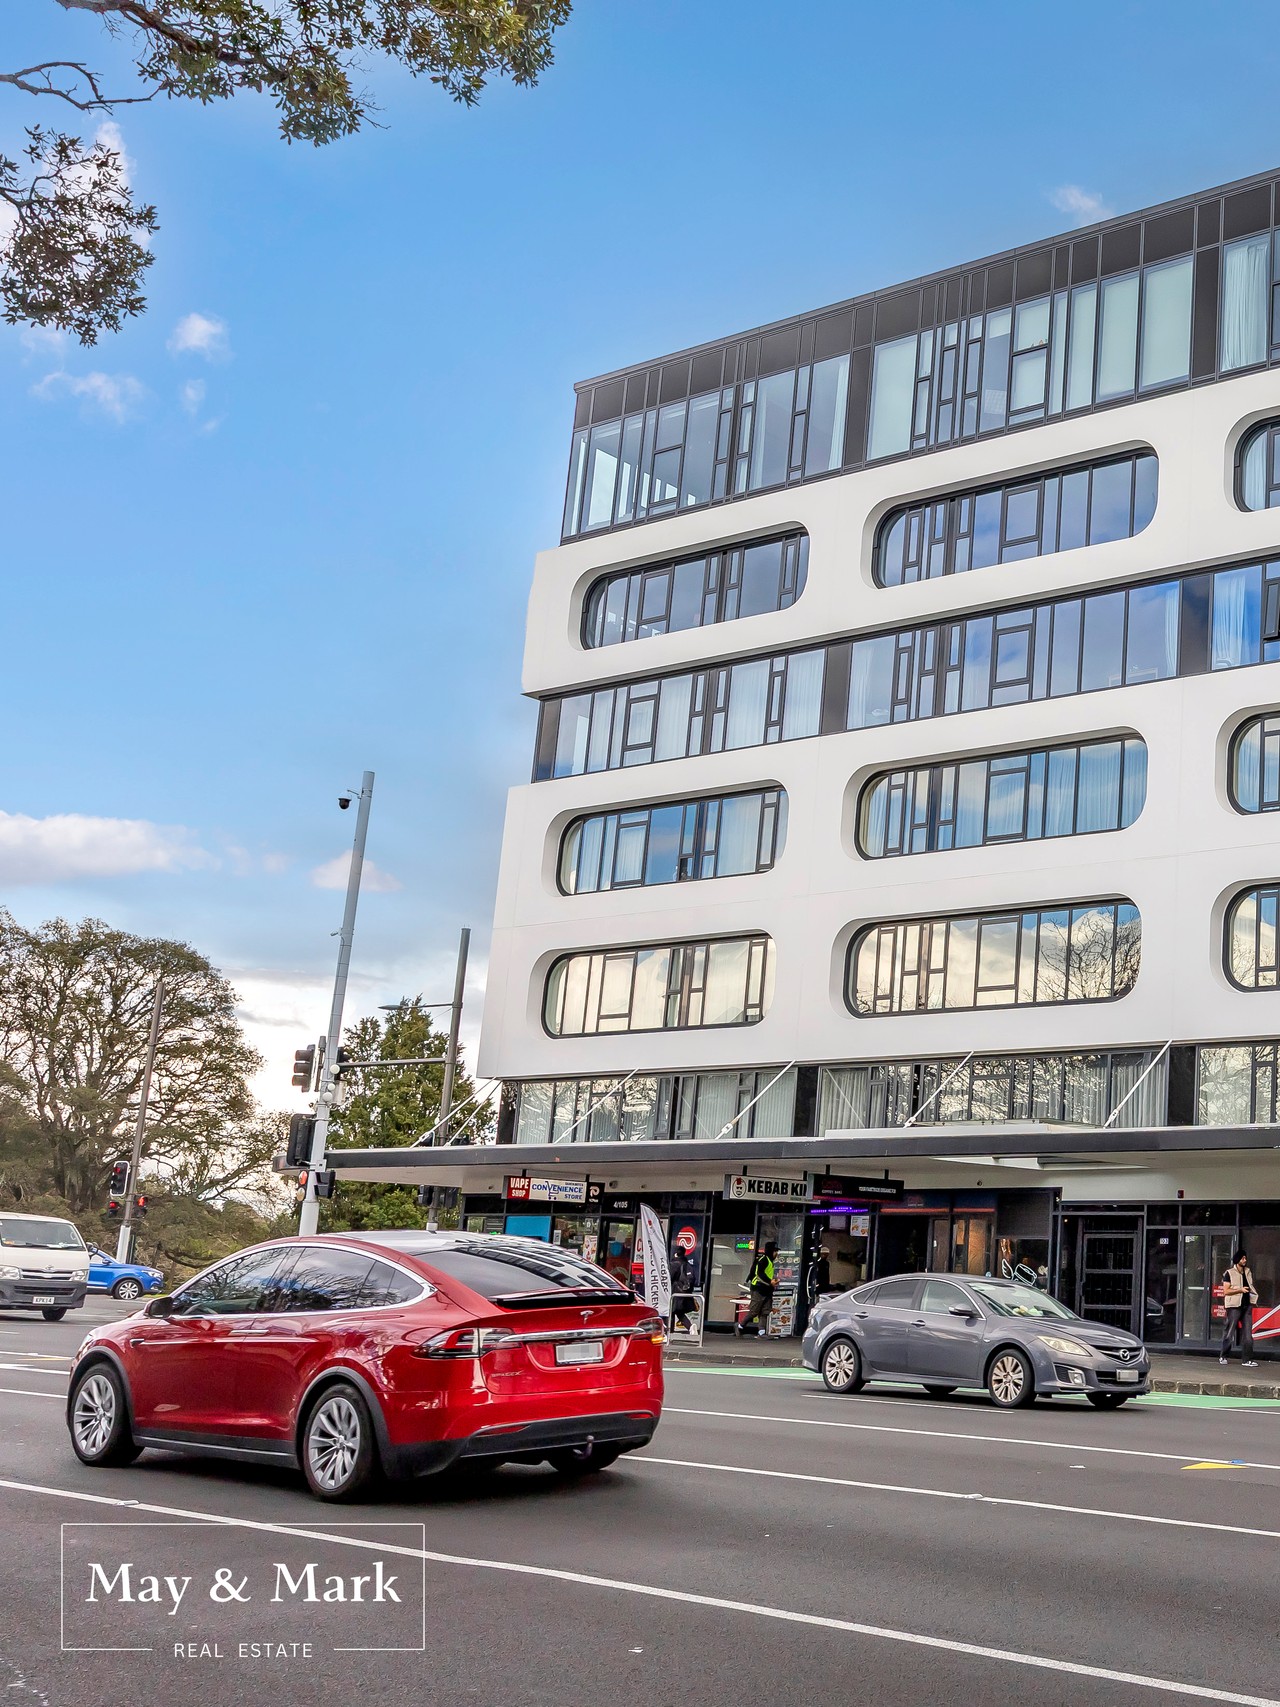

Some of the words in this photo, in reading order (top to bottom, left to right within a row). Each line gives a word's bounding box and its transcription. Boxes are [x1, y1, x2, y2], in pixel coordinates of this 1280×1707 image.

[510, 1177, 529, 1189] VAPE
[531, 1182, 583, 1194] CONVENIENCE
[747, 1179, 789, 1195] KEBAB
[511, 1189, 526, 1197] SHOP
